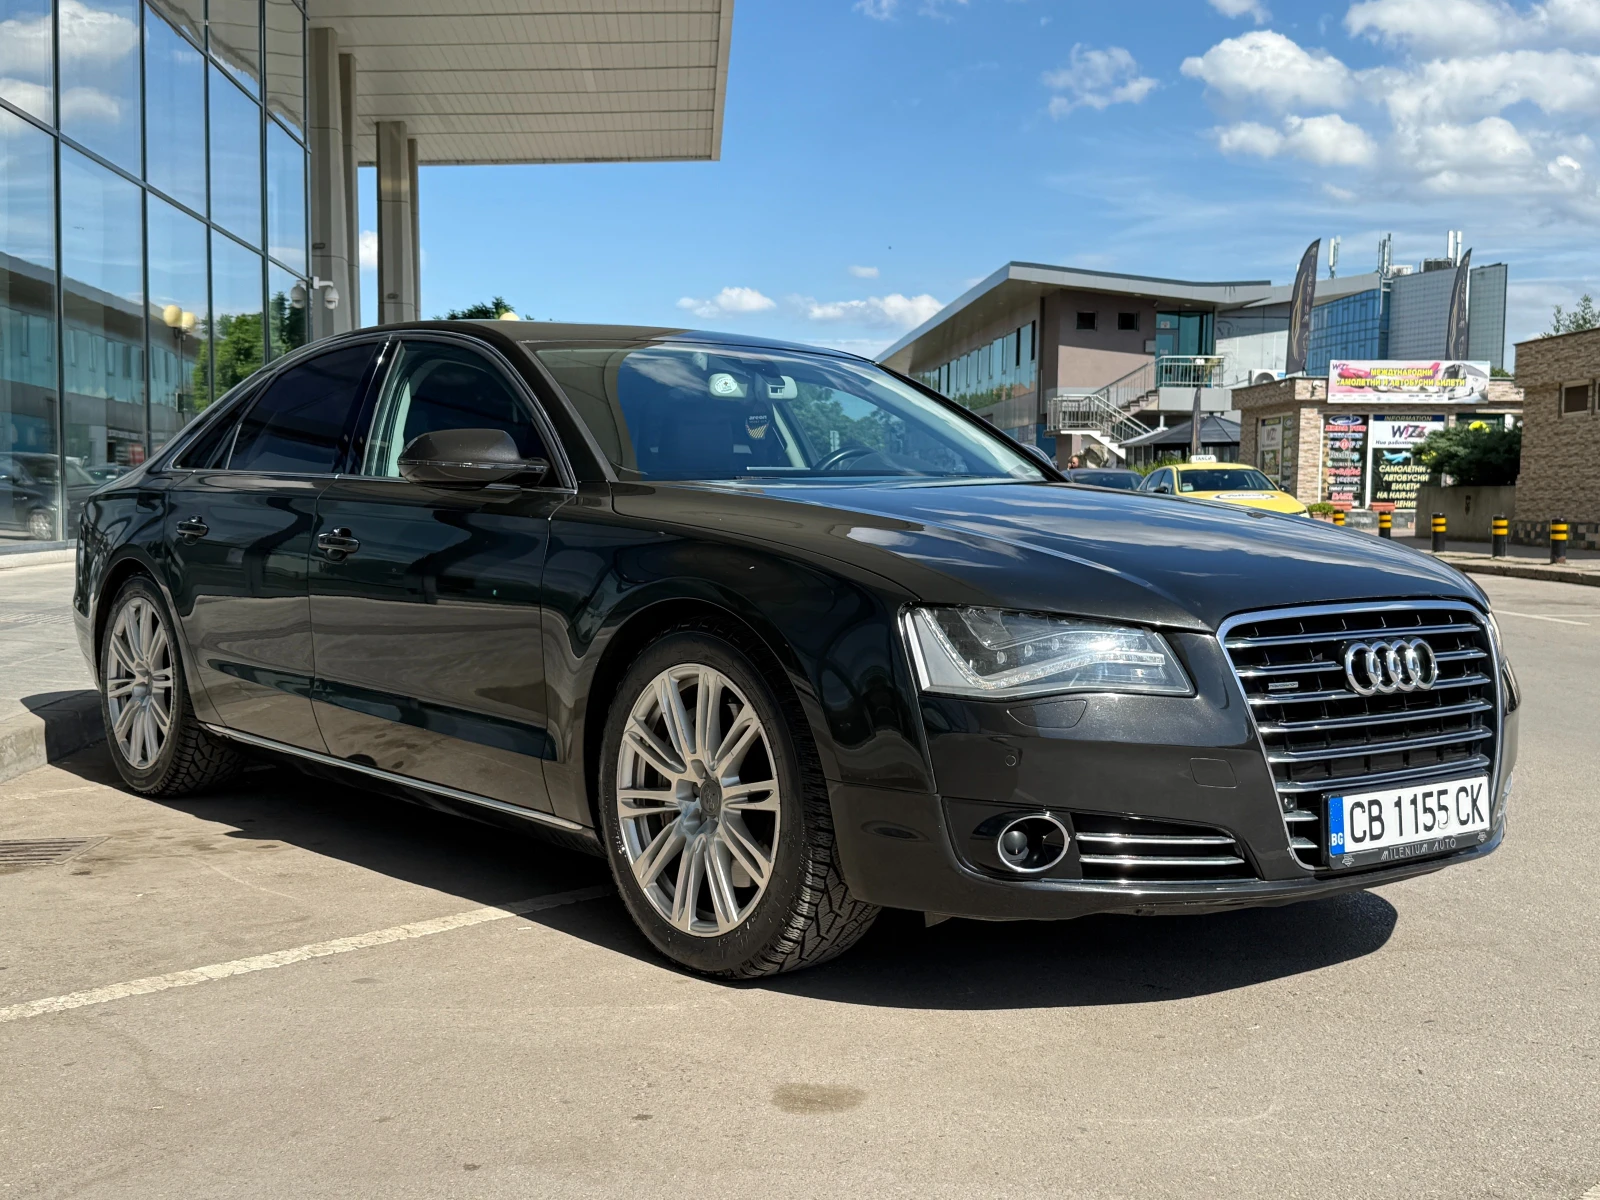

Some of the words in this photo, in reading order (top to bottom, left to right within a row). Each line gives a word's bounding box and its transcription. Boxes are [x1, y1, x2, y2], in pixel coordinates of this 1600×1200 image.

[1302, 247, 1317, 323] MILENIUM
[1370, 367, 1433, 377] МЕЖДУНАРОДНИ
[1335, 378, 1381, 387] САМОЛЕТНИ
[1383, 379, 1388, 387] И
[1390, 378, 1434, 387] АВТОБУСНИ
[1435, 378, 1465, 387] БИЛЕТИ
[1379, 465, 1426, 473] САМОЛЕТНИ
[1383, 474, 1429, 482] АВТОБУСНИ
[1350, 799, 1385, 843] CB
[1394, 789, 1450, 837] 1155
[1455, 783, 1485, 826] CK
[1331, 832, 1344, 847] BG
[1380, 844, 1428, 861] MILENIUM
[1432, 838, 1457, 851] AUTO
